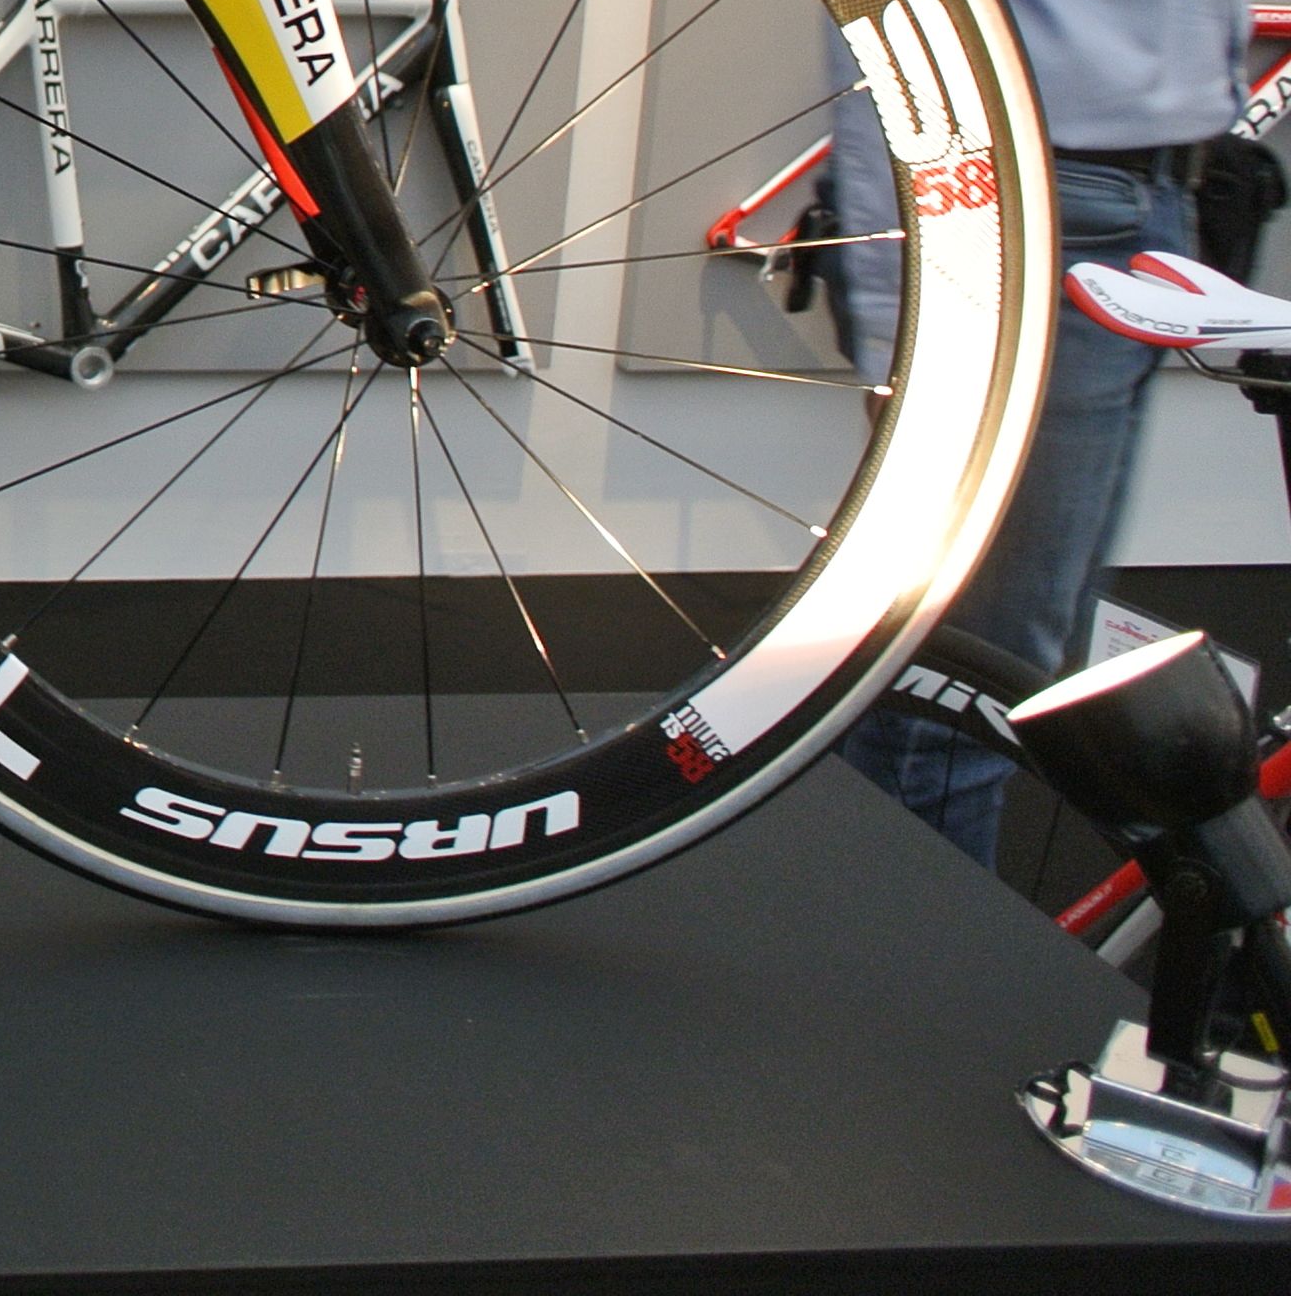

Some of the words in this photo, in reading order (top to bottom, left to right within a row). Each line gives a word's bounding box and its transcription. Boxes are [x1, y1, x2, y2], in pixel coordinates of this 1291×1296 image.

[913, 159, 1000, 217] 58
[1108, 301, 1190, 335] marco
[674, 704, 732, 762] miura
[118, 786, 582, 863] URSUS
